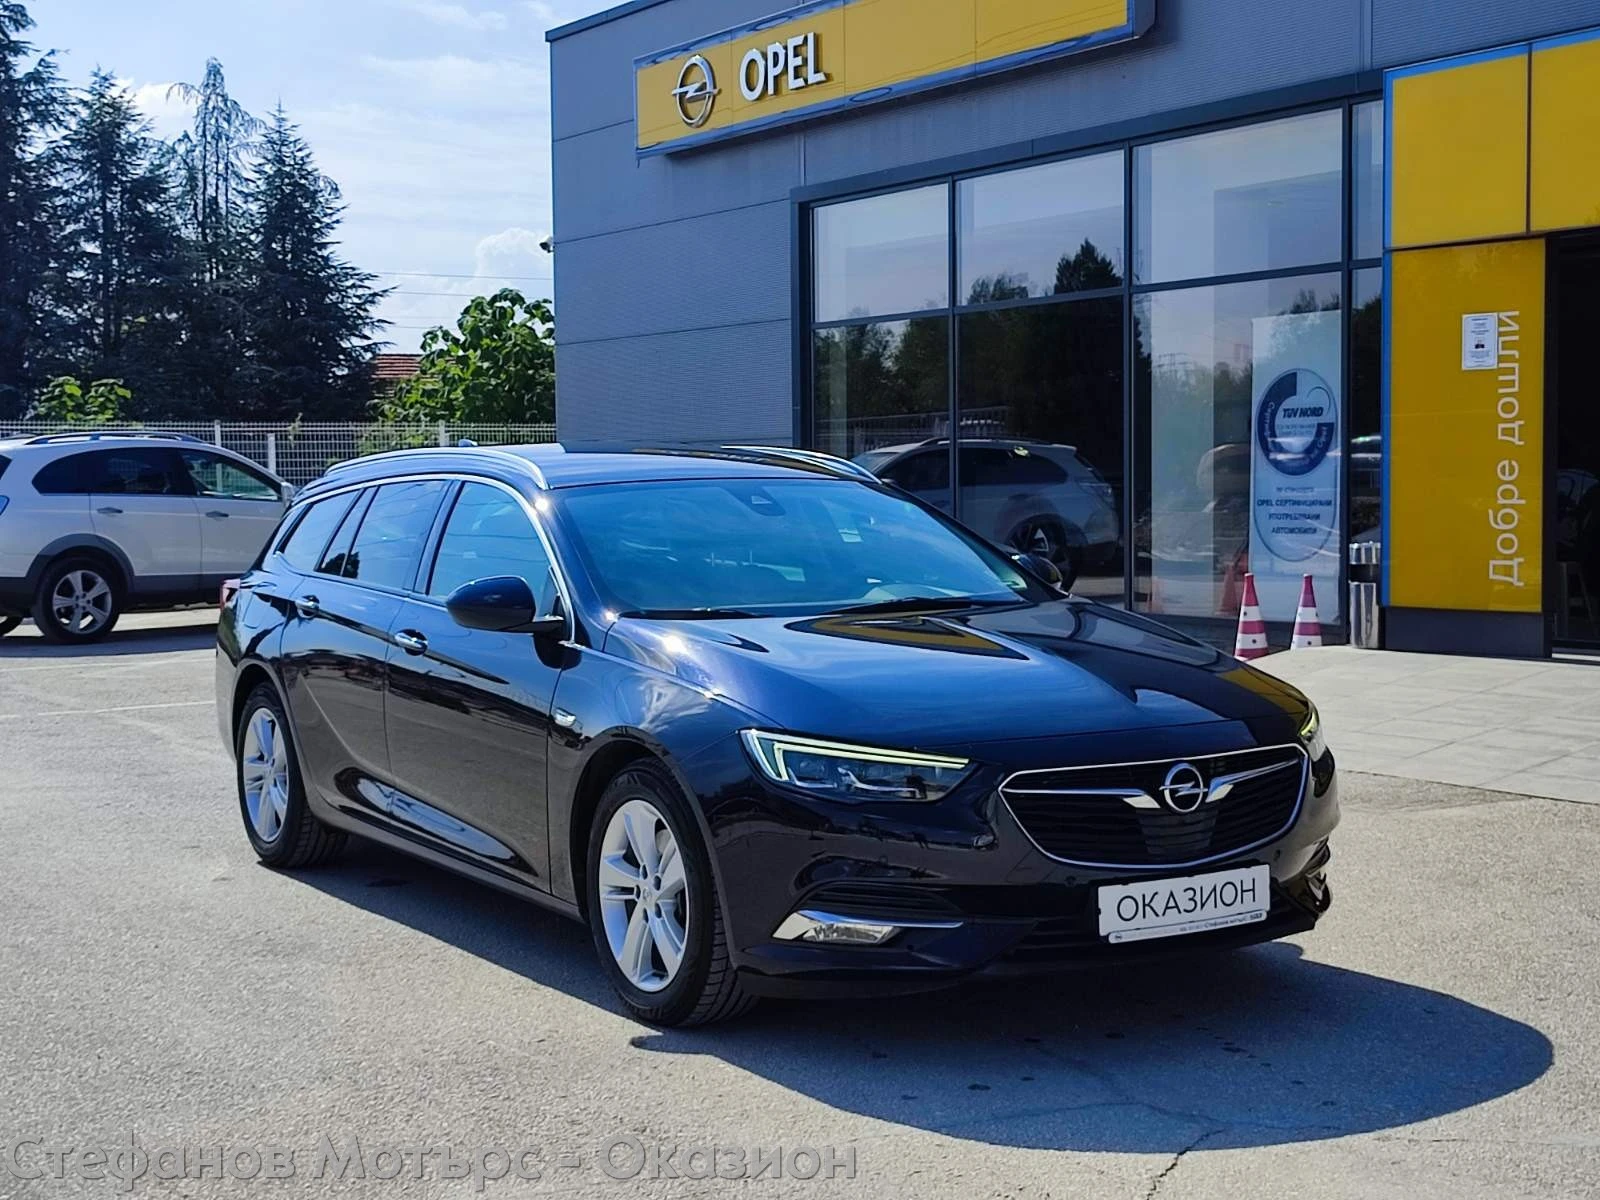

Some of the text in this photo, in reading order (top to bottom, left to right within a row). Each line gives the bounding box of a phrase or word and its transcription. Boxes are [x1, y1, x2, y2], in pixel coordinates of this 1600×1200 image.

[739, 31, 827, 101] OPEL
[1299, 407, 1324, 417] NORD
[1489, 310, 1526, 587] Добре дошли
[1116, 878, 1257, 922] ОКАЗИОН
